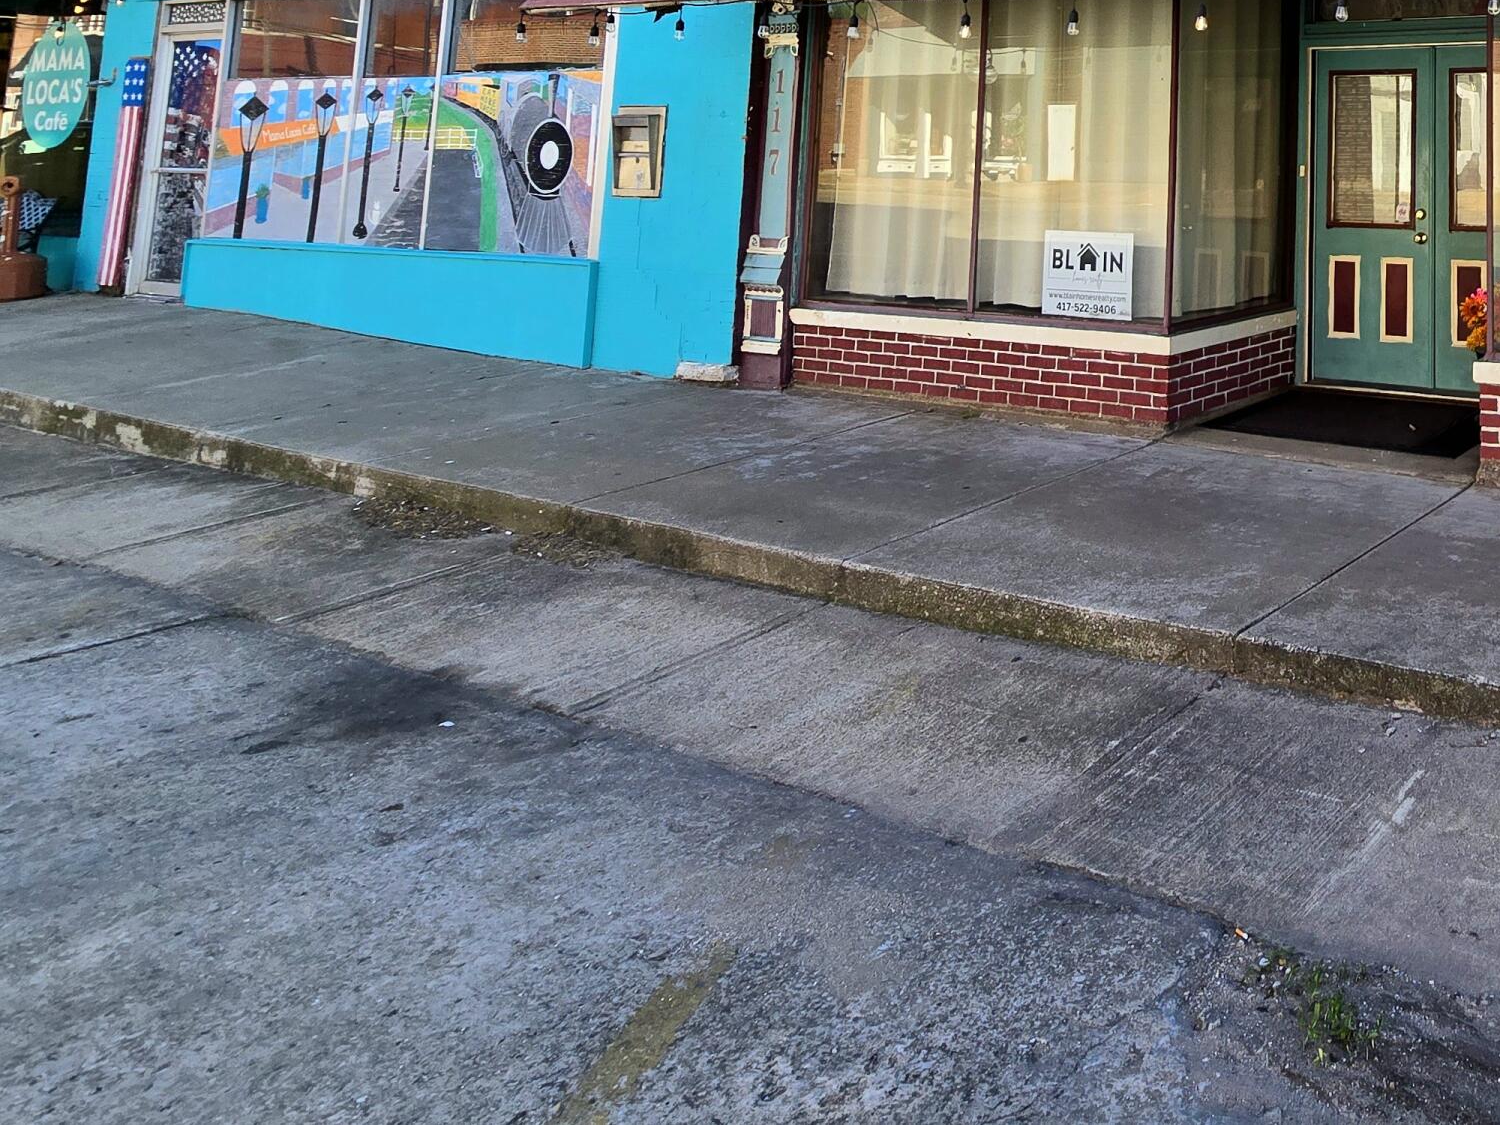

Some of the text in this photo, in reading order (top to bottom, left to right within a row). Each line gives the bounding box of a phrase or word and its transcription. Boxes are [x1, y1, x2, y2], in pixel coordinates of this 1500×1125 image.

[31, 47, 85, 73] MAMA
[26, 78, 83, 105] LOCA'S
[34, 111, 68, 131] Café
[1056, 302, 1117, 315] 417-522-9406
